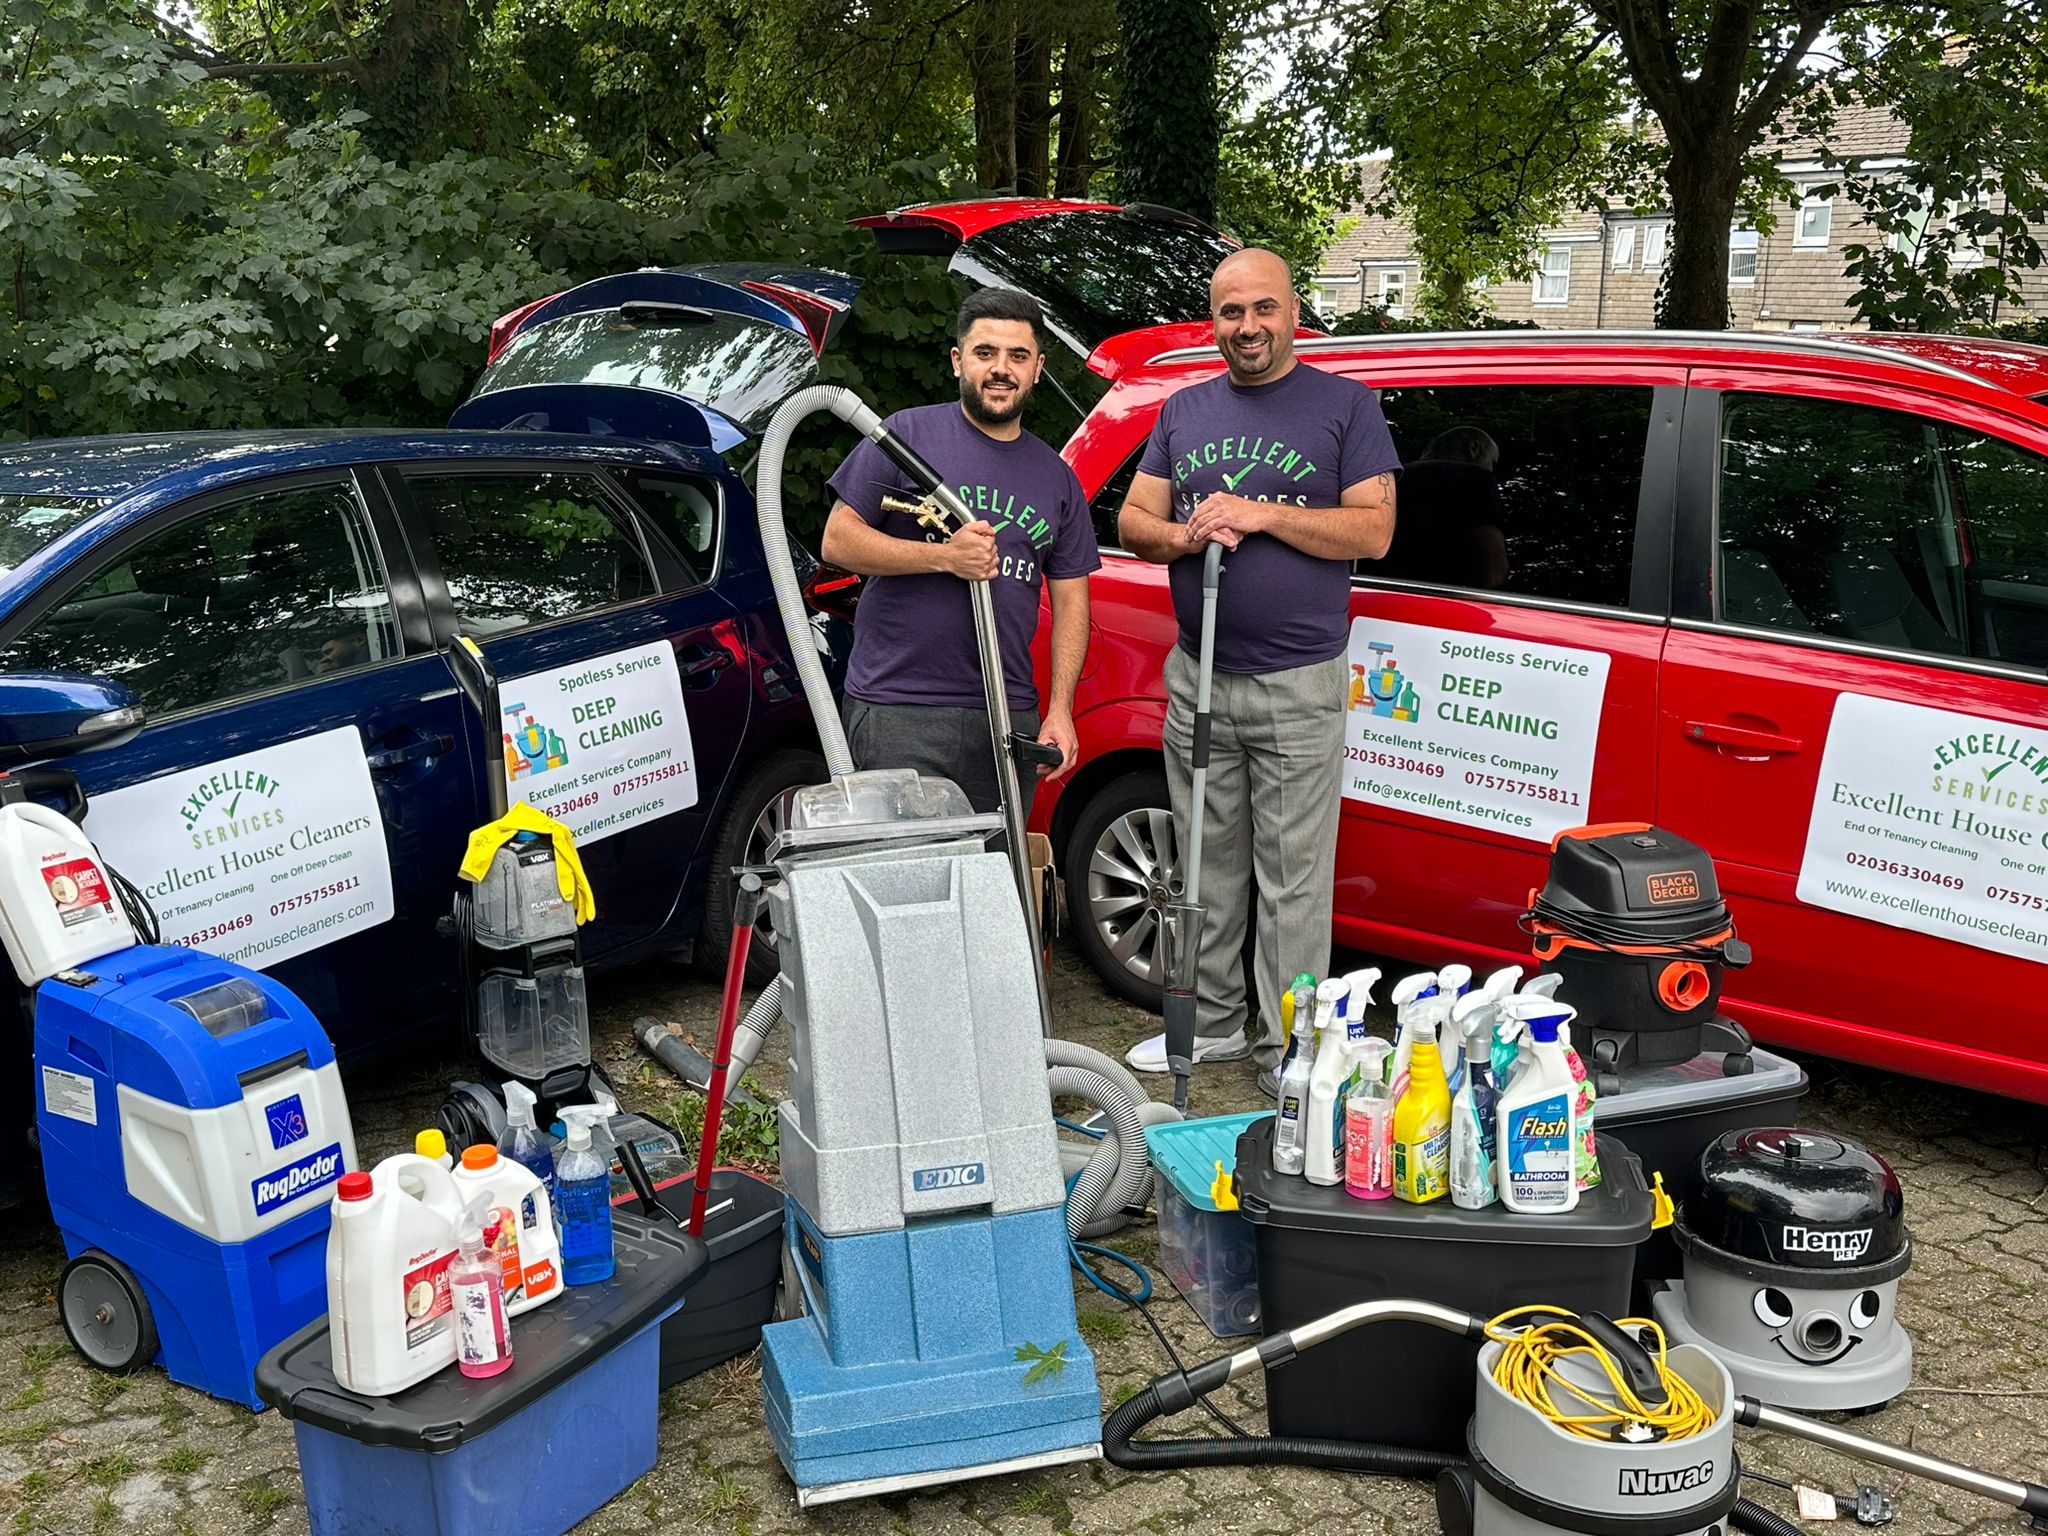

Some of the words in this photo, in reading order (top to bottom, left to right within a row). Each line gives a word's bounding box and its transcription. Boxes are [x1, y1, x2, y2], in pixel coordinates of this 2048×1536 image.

[1175, 436, 1317, 482] EXCELLENT
[959, 485, 1057, 550] CELLENT
[558, 668, 614, 693] Spotless
[616, 653, 661, 676] Service
[1440, 640, 1515, 665] Spotless
[1520, 652, 1590, 677] Service
[1441, 673, 1503, 700] DEEP
[571, 696, 617, 725] DEEP
[578, 709, 664, 751] CLEANING
[1437, 702, 1559, 740] CLEANING
[1363, 729, 1423, 752] Excellent
[1427, 741, 1486, 764] Services
[1490, 754, 1559, 780] Company
[528, 777, 579, 804] Excellent
[581, 765, 625, 787] Services
[627, 747, 672, 772] Company
[541, 791, 599, 819] 6330469
[613, 760, 690, 797] 07575755811
[1465, 771, 1580, 807] 07575755811
[1932, 775, 2048, 816] SERVICES
[180, 769, 280, 823] EXCELLENT
[1353, 776, 1533, 827] info@excellent.services
[1831, 782, 1943, 826] Excellent
[1950, 808, 2032, 847] House
[192, 808, 285, 850] SERVICES
[570, 796, 664, 841] xcellent.services
[139, 864, 217, 901] cellent
[220, 841, 285, 875] House
[289, 812, 371, 851] Cleaners
[1844, 820, 1865, 833] End
[1868, 826, 1881, 836] Of
[1883, 829, 1927, 849] Tenancy
[1930, 841, 1979, 861] Cleaning
[2000, 857, 2024, 871] One
[2027, 863, 2046, 876] Off
[162, 910, 174, 920] Of
[175, 897, 213, 915] Tenancy
[215, 883, 254, 902] Cleaning
[270, 870, 288, 884] One
[289, 863, 305, 879] Off
[305, 858, 327, 877] Deep
[328, 850, 353, 870] Clean
[1651, 876, 1693, 889] BLACK+
[1846, 852, 1964, 891] 02036330469
[270, 875, 360, 917] 07575755811
[1653, 886, 1695, 899] DECKER
[271, 1110, 304, 1148] X3
[1519, 1116, 1567, 1137] Flash
[919, 1166, 977, 1189] EDIC
[1514, 1173, 1566, 1181] BATHROOM
[1784, 1225, 1872, 1255] Henry
[1835, 1249, 1857, 1261] PET
[1619, 1460, 1714, 1495] Nuvac
